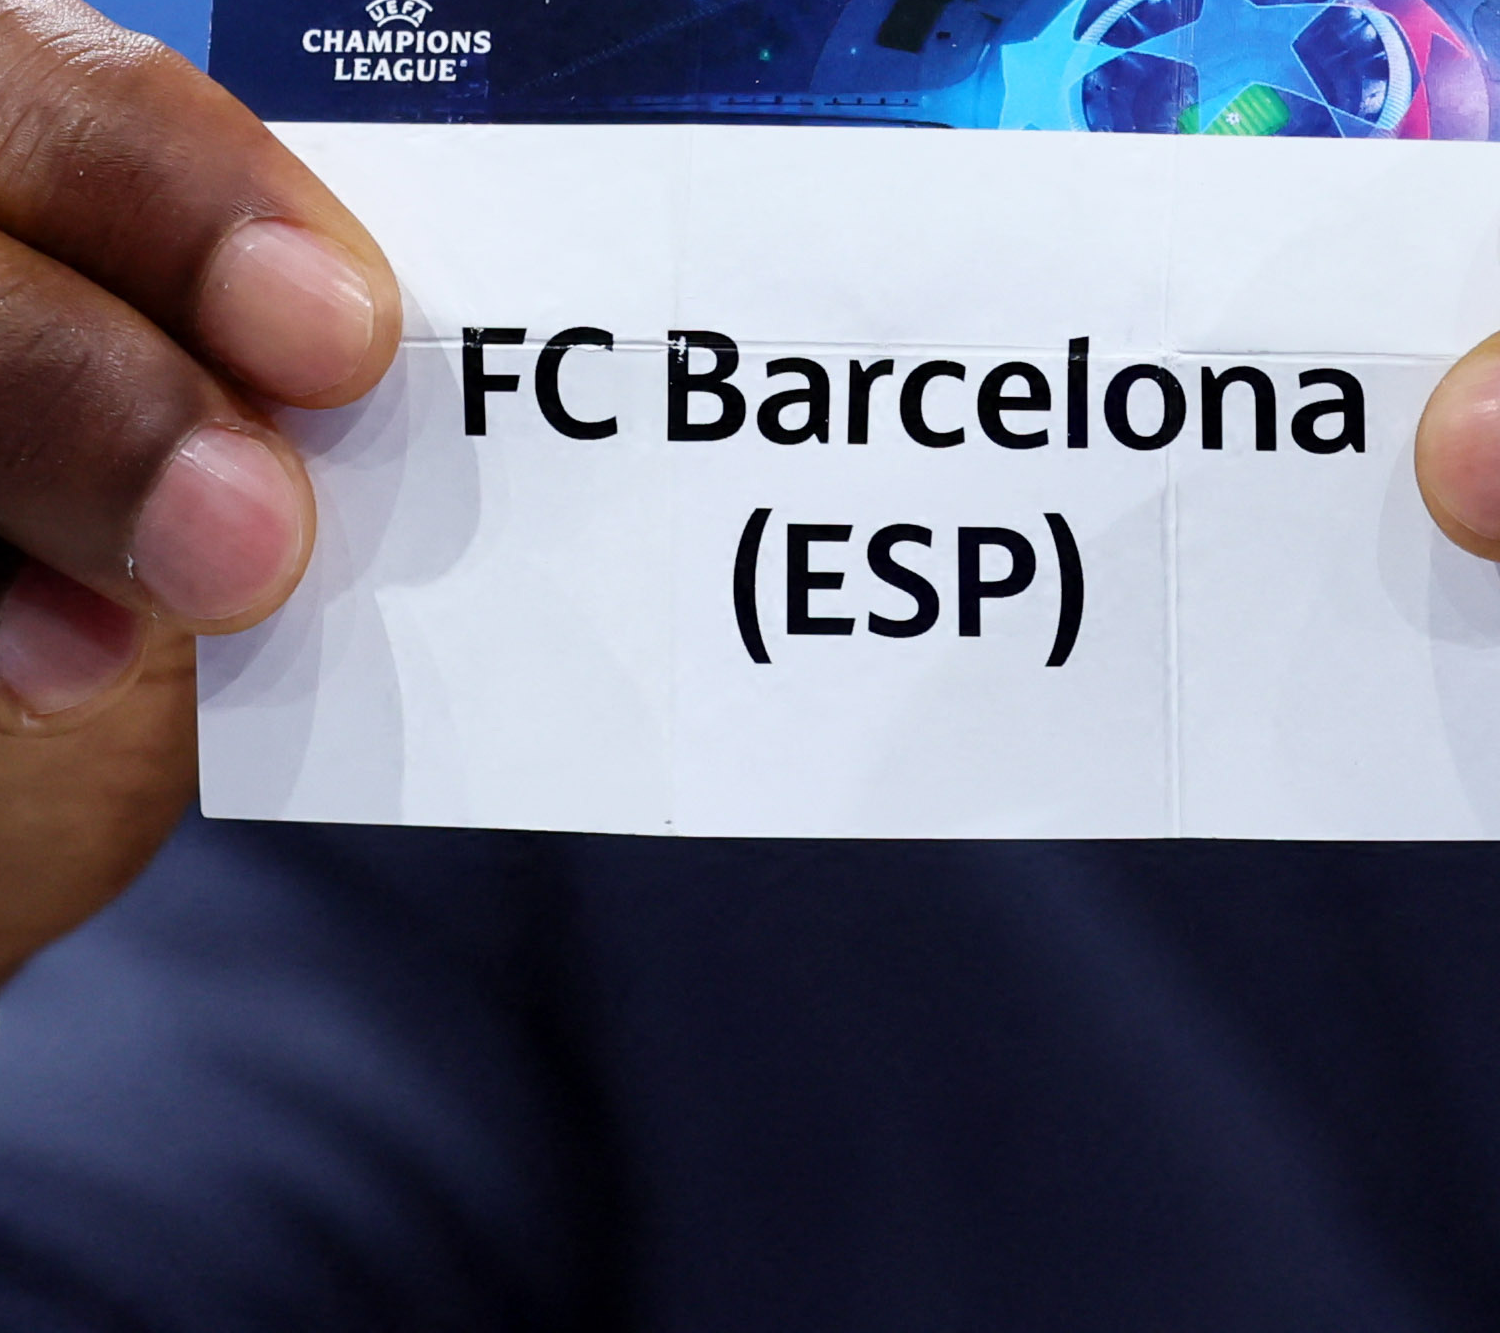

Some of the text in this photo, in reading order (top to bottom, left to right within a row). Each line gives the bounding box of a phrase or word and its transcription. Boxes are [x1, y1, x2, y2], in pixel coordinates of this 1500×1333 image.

[302, 29, 492, 54] CHAMPIONS
[462, 326, 1366, 455] FC Barcelona
[733, 507, 1085, 667] (ESP)
